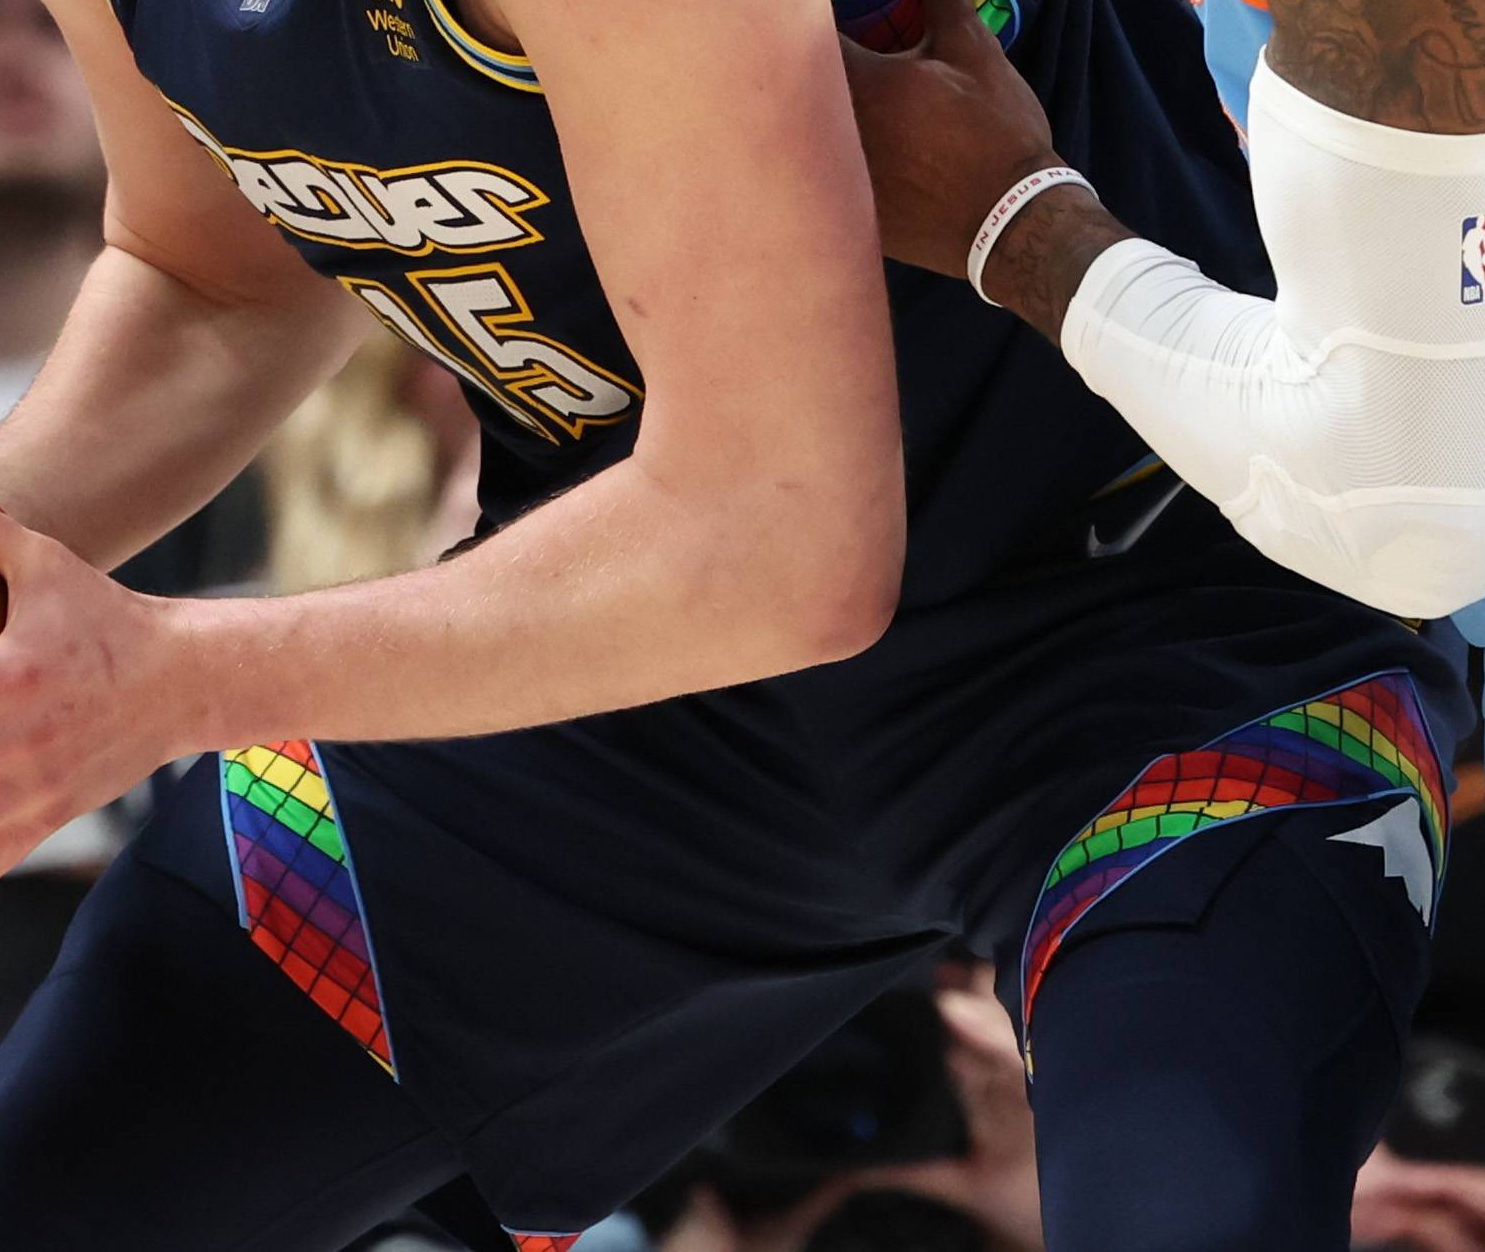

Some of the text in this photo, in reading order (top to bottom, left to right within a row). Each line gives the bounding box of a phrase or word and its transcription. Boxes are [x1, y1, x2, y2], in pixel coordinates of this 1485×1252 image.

[366, 9, 416, 39] Western
[386, 34, 420, 61] Union
[975, 230, 990, 251] IN
[990, 176, 1042, 227] JESUS
[336, 262, 646, 446] 15
